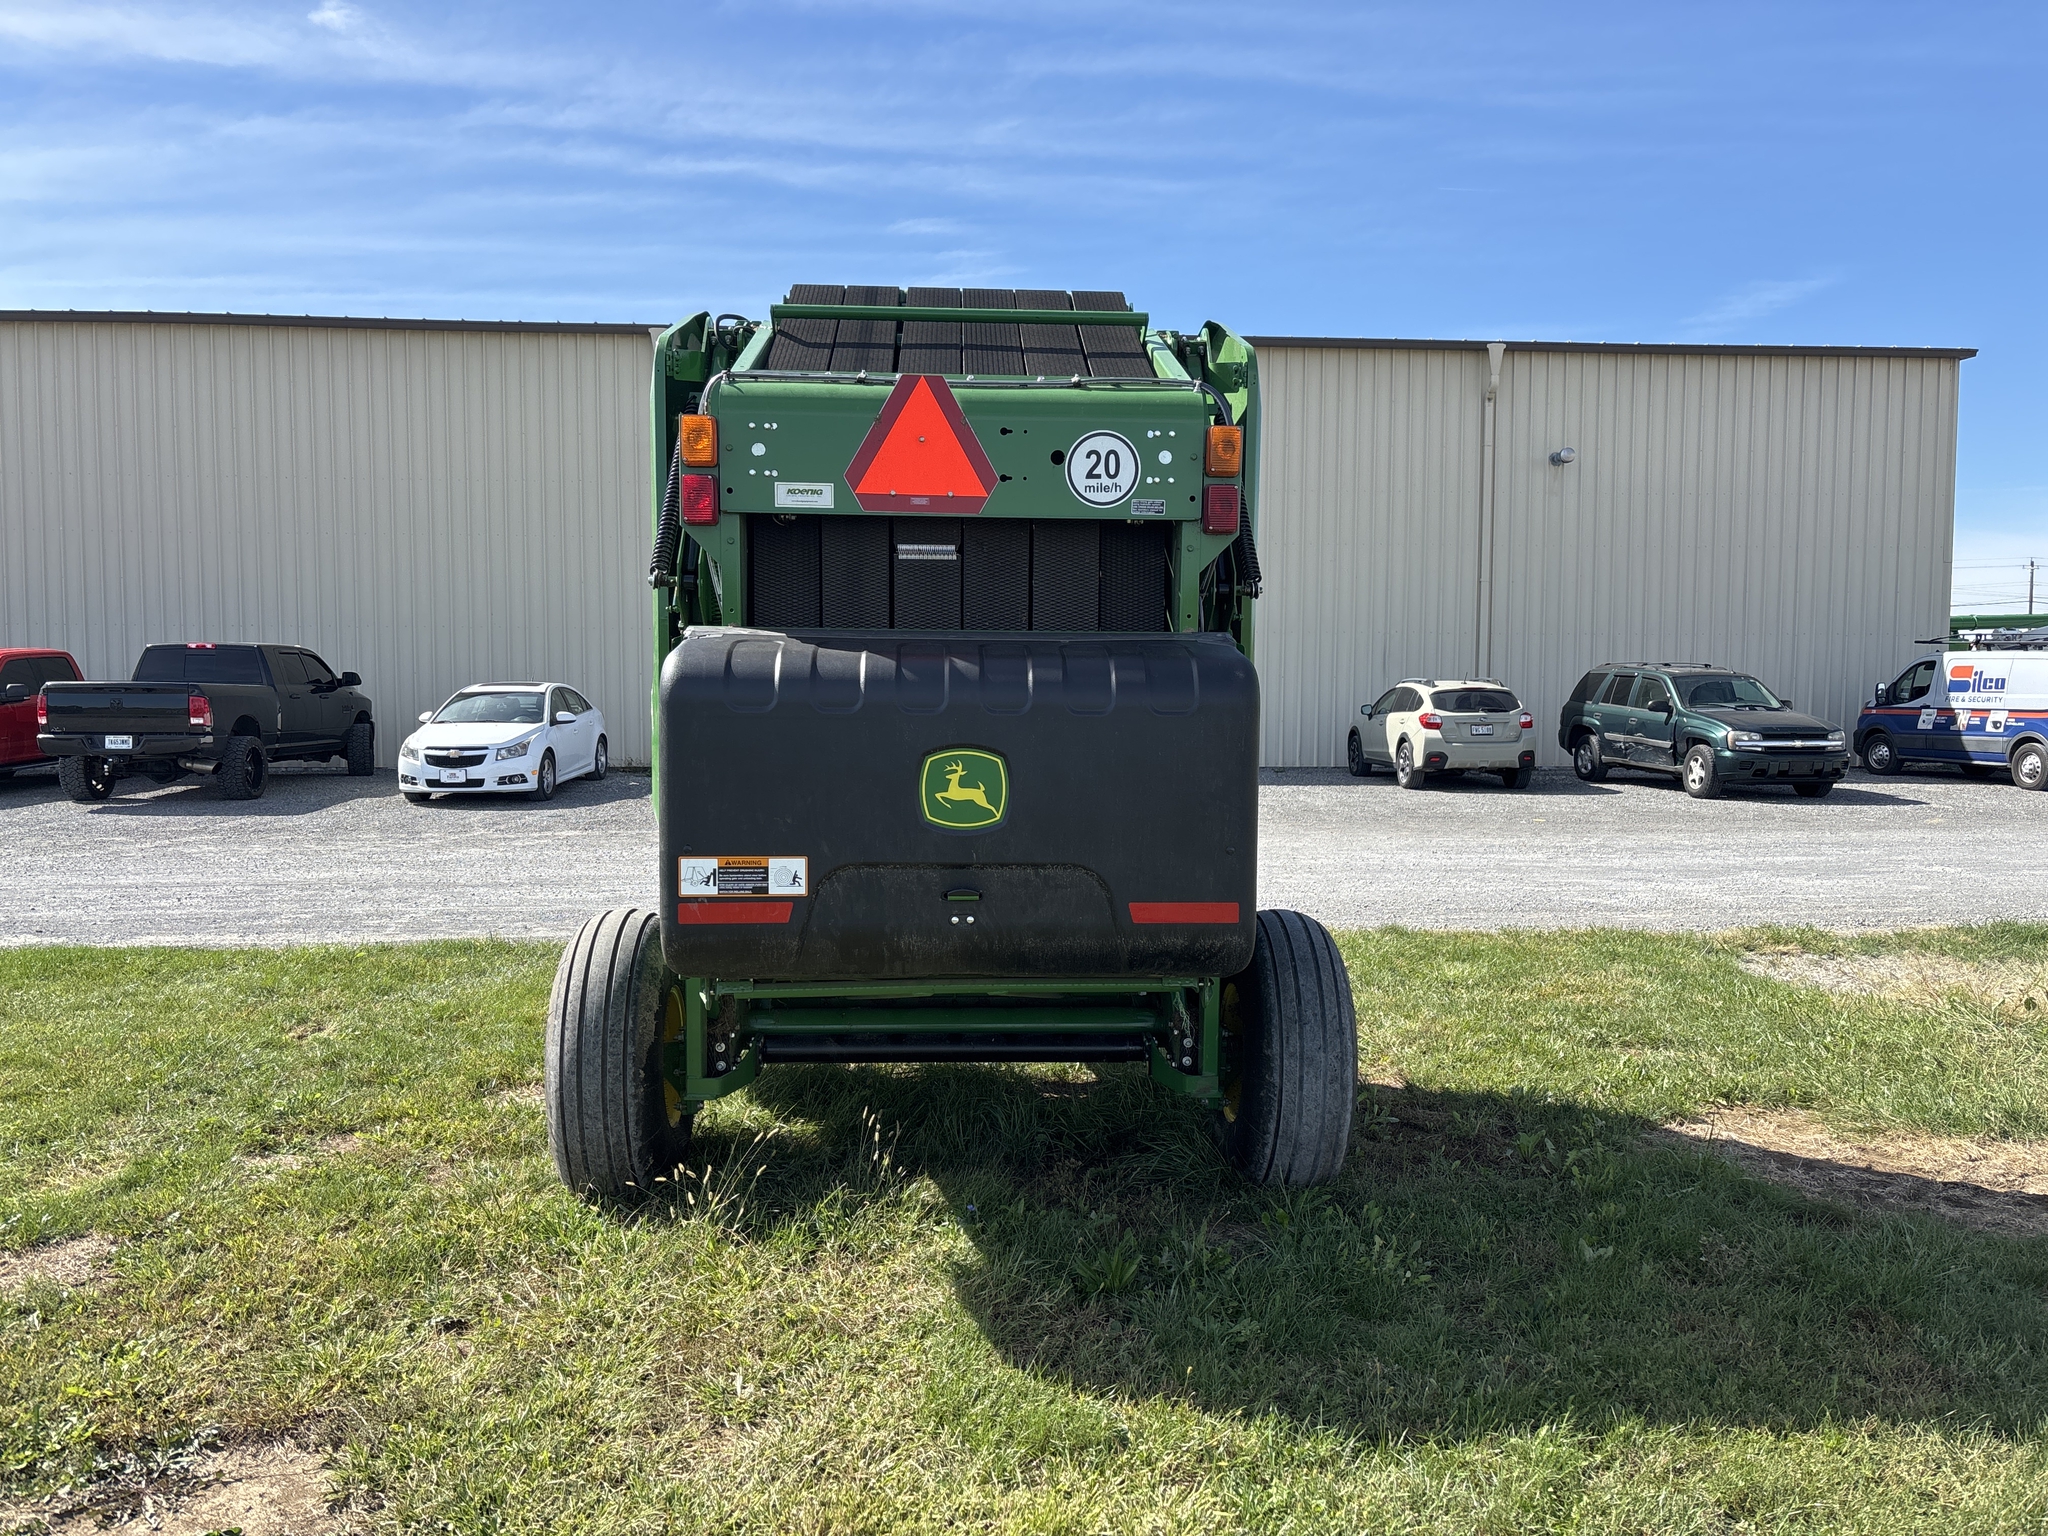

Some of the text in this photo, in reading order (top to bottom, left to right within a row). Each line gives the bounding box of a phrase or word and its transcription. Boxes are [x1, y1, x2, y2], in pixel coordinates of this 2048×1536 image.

[1085, 449, 1120, 480] 20
[1084, 482, 1122, 493] mile/h
[1947, 665, 2006, 694] Silco
[1961, 695, 1966, 703] &
